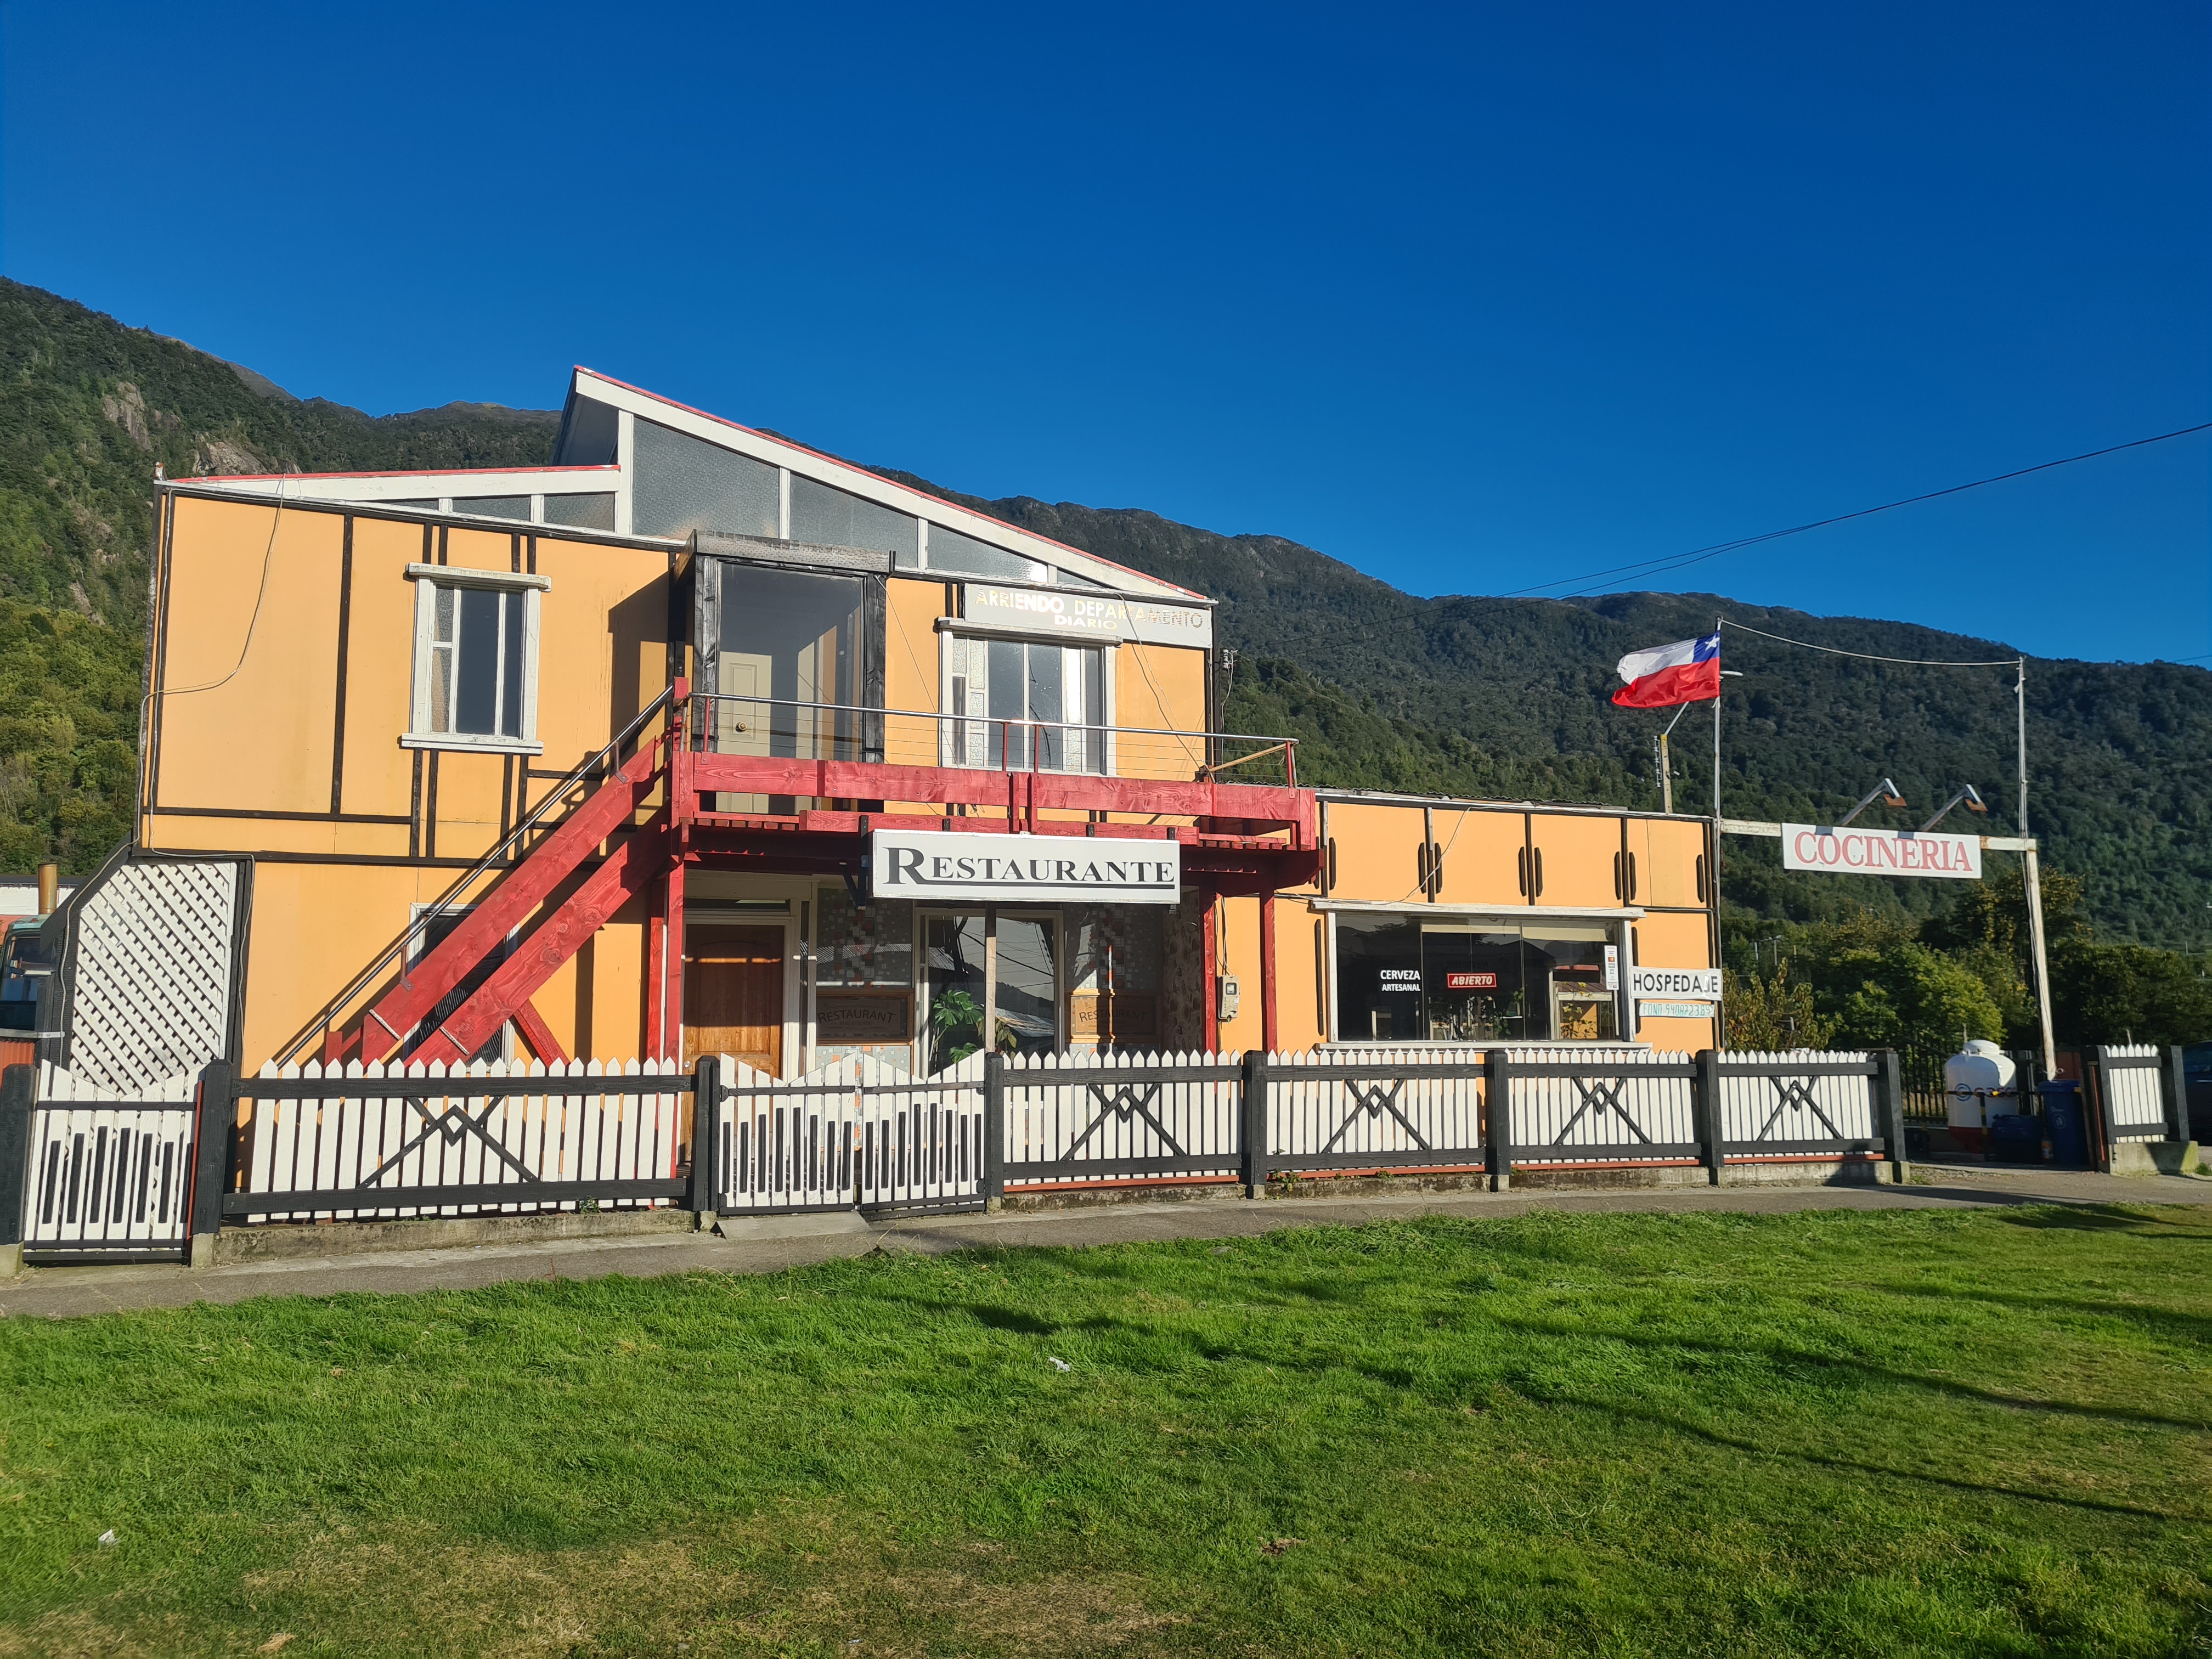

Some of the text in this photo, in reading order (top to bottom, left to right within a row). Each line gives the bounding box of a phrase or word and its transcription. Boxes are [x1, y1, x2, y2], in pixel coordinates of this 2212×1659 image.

[975, 588, 1203, 628] ARRIENDO DEPARTAMENTO
[1054, 615, 1118, 630] DIARIO
[1795, 831, 1973, 872] COCINERIA
[882, 847, 1175, 885] RESTAURANTE
[1380, 970, 1421, 980] CERVEZA
[1452, 975, 1493, 985] ABIERTO
[1633, 973, 1718, 993] HOSPEDAJE
[817, 1009, 896, 1024] RESTAURANT
